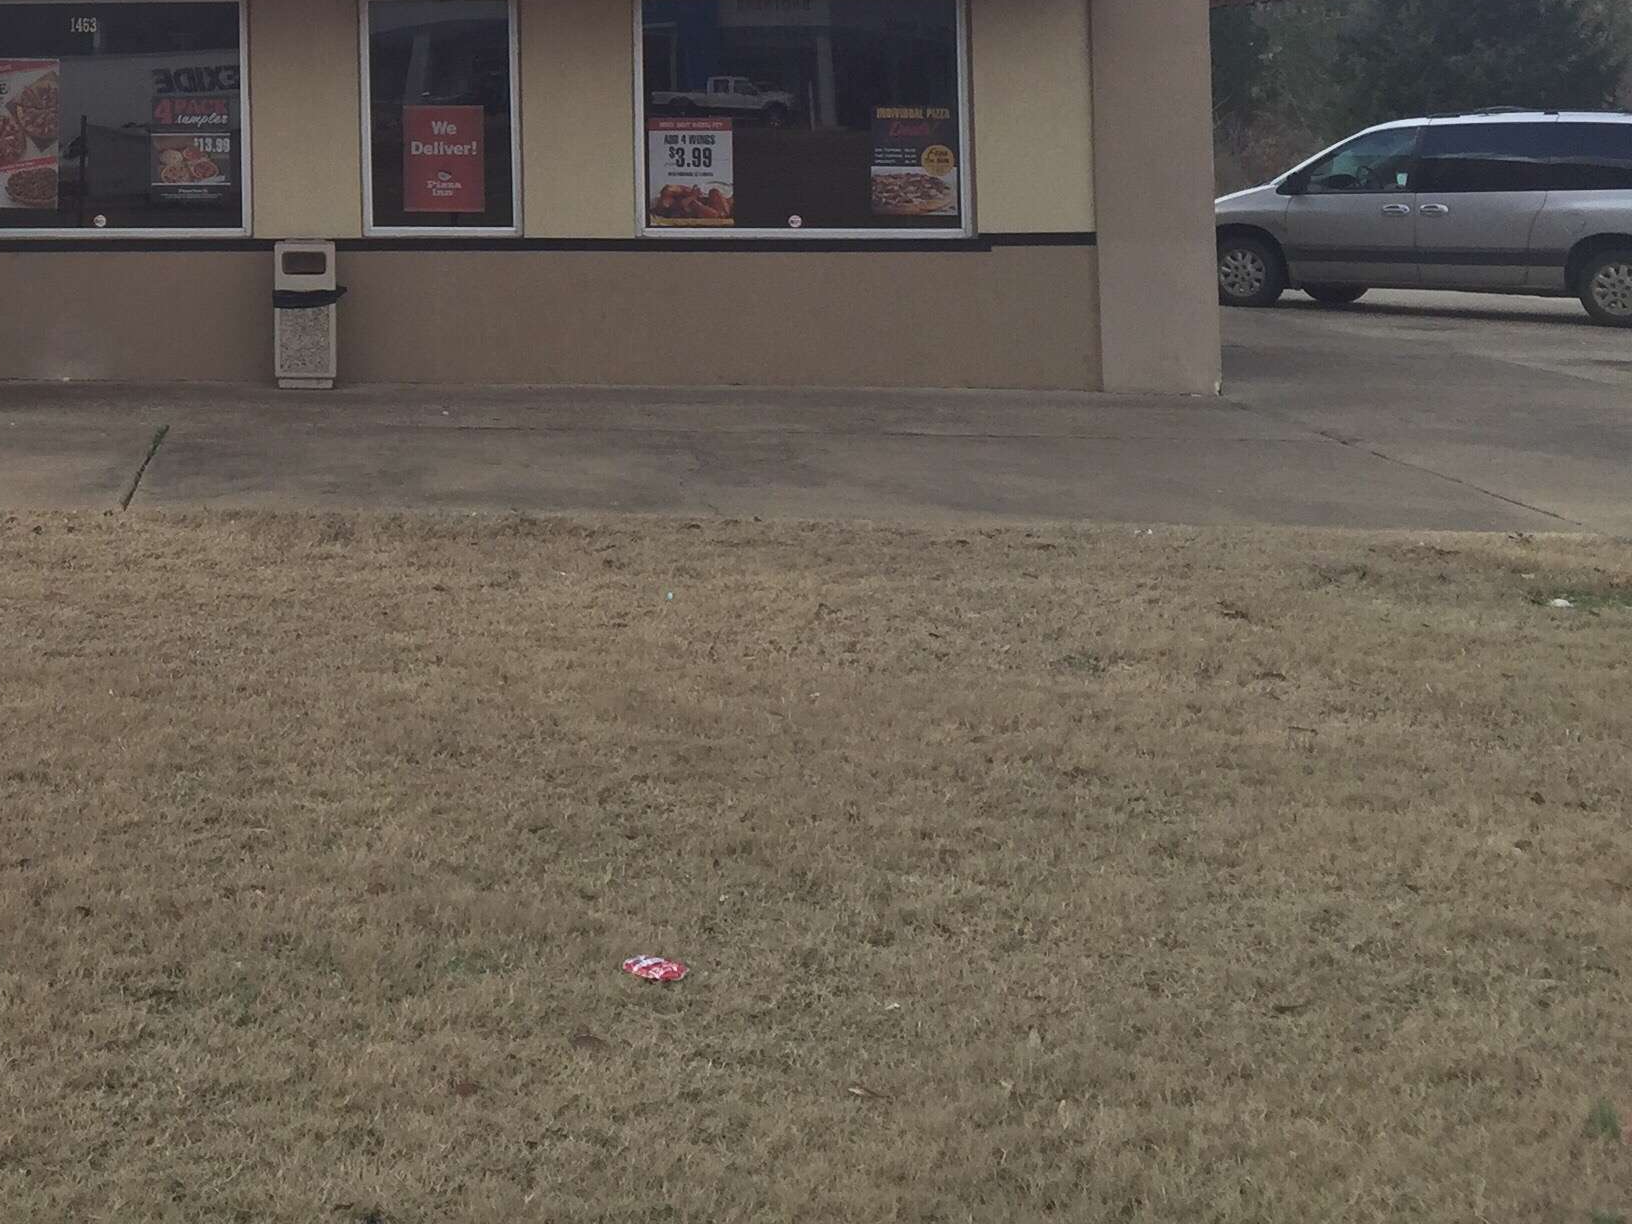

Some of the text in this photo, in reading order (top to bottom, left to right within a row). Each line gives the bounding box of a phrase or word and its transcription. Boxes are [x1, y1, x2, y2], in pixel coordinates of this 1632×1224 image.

[70, 17, 97, 33] 1463
[154, 98, 174, 125] 4
[431, 120, 457, 135] We
[681, 134, 686, 144] 4
[689, 134, 716, 145] WINGS
[411, 140, 478, 155] Deliver!
[668, 146, 713, 168] $3.99
